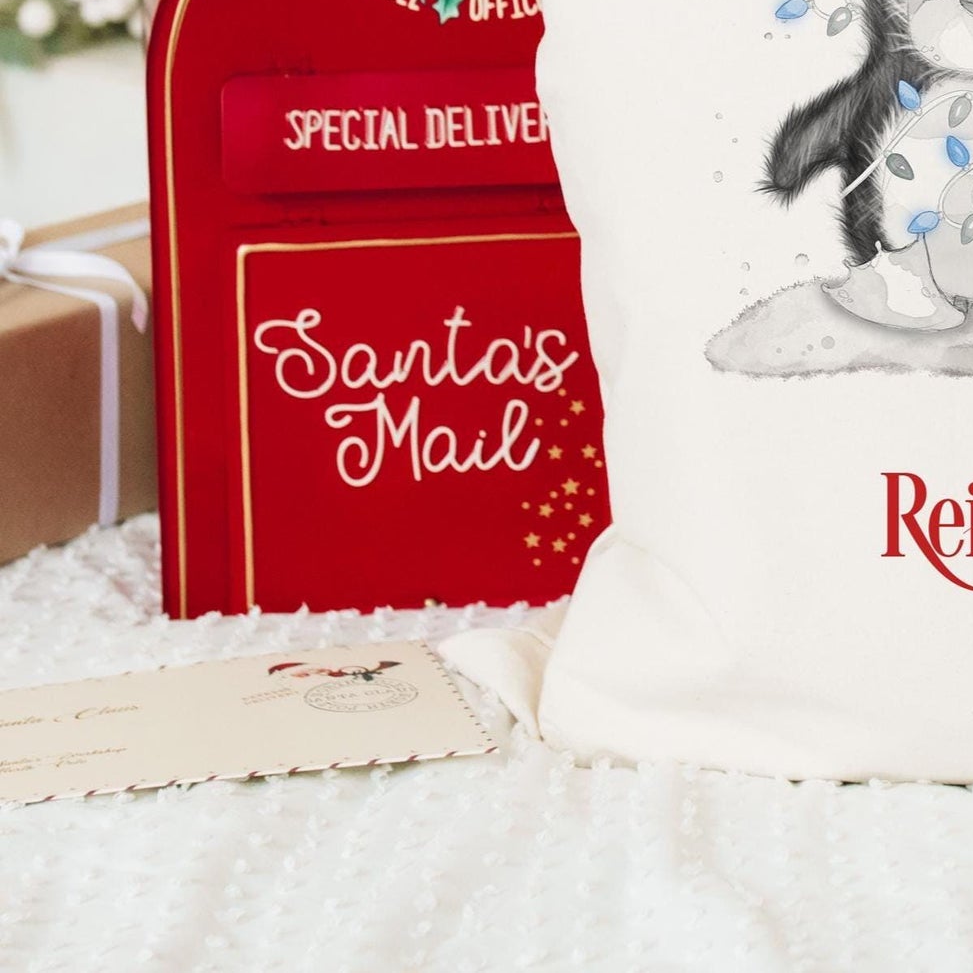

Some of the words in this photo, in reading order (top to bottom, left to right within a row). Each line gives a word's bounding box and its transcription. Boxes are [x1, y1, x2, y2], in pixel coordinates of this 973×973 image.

[284, 107, 419, 151] SPECIAL
[253, 306, 579, 399] Santa's
[324, 392, 541, 487] Mail
